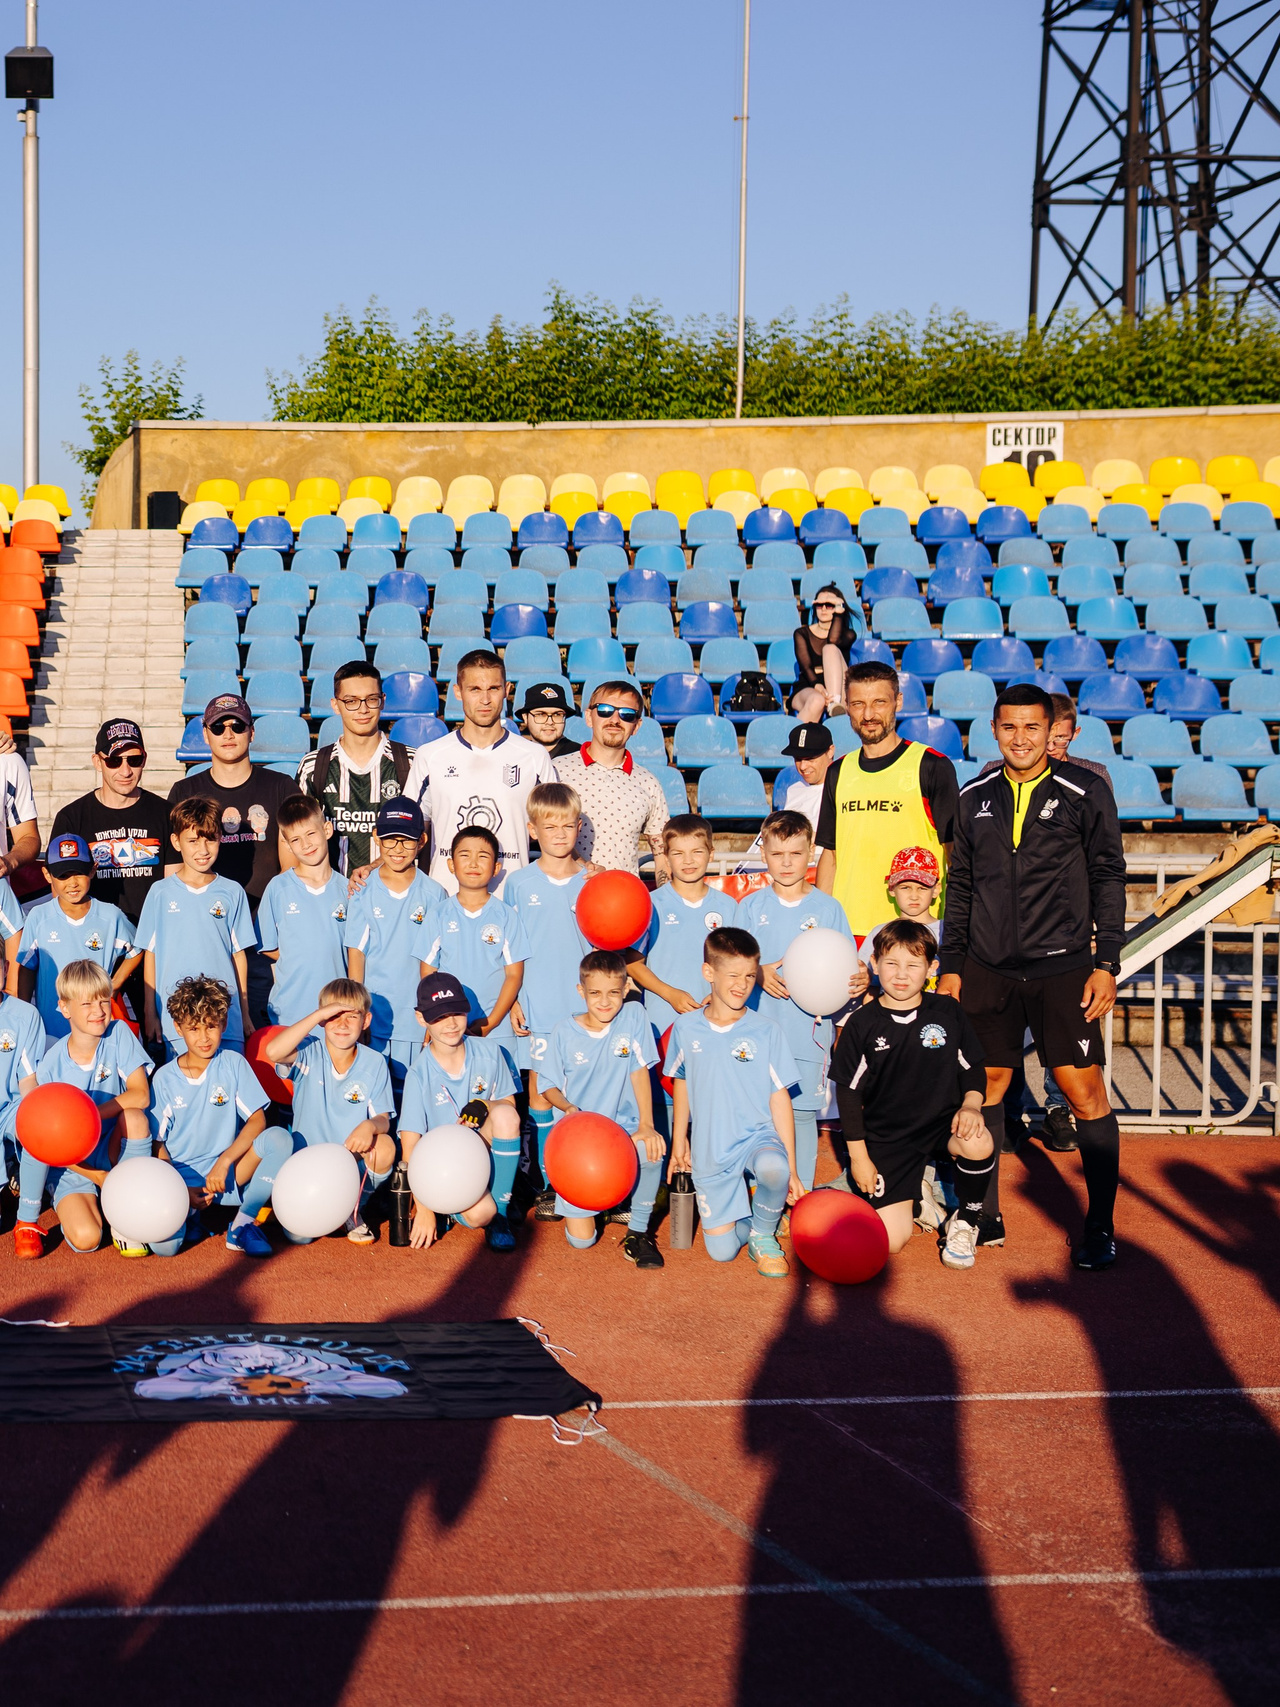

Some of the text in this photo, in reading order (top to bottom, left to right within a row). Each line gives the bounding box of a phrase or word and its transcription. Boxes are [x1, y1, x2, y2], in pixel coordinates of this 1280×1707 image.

[992, 427, 1057, 446] СЕКТОР
[841, 800, 889, 813] KELME
[333, 806, 376, 822] Team
[95, 827, 148, 841] ЮЖНЫЙ УРАЛ
[96, 866, 153, 879] МАГНИТОГОРСК
[431, 989, 454, 1001] FILA
